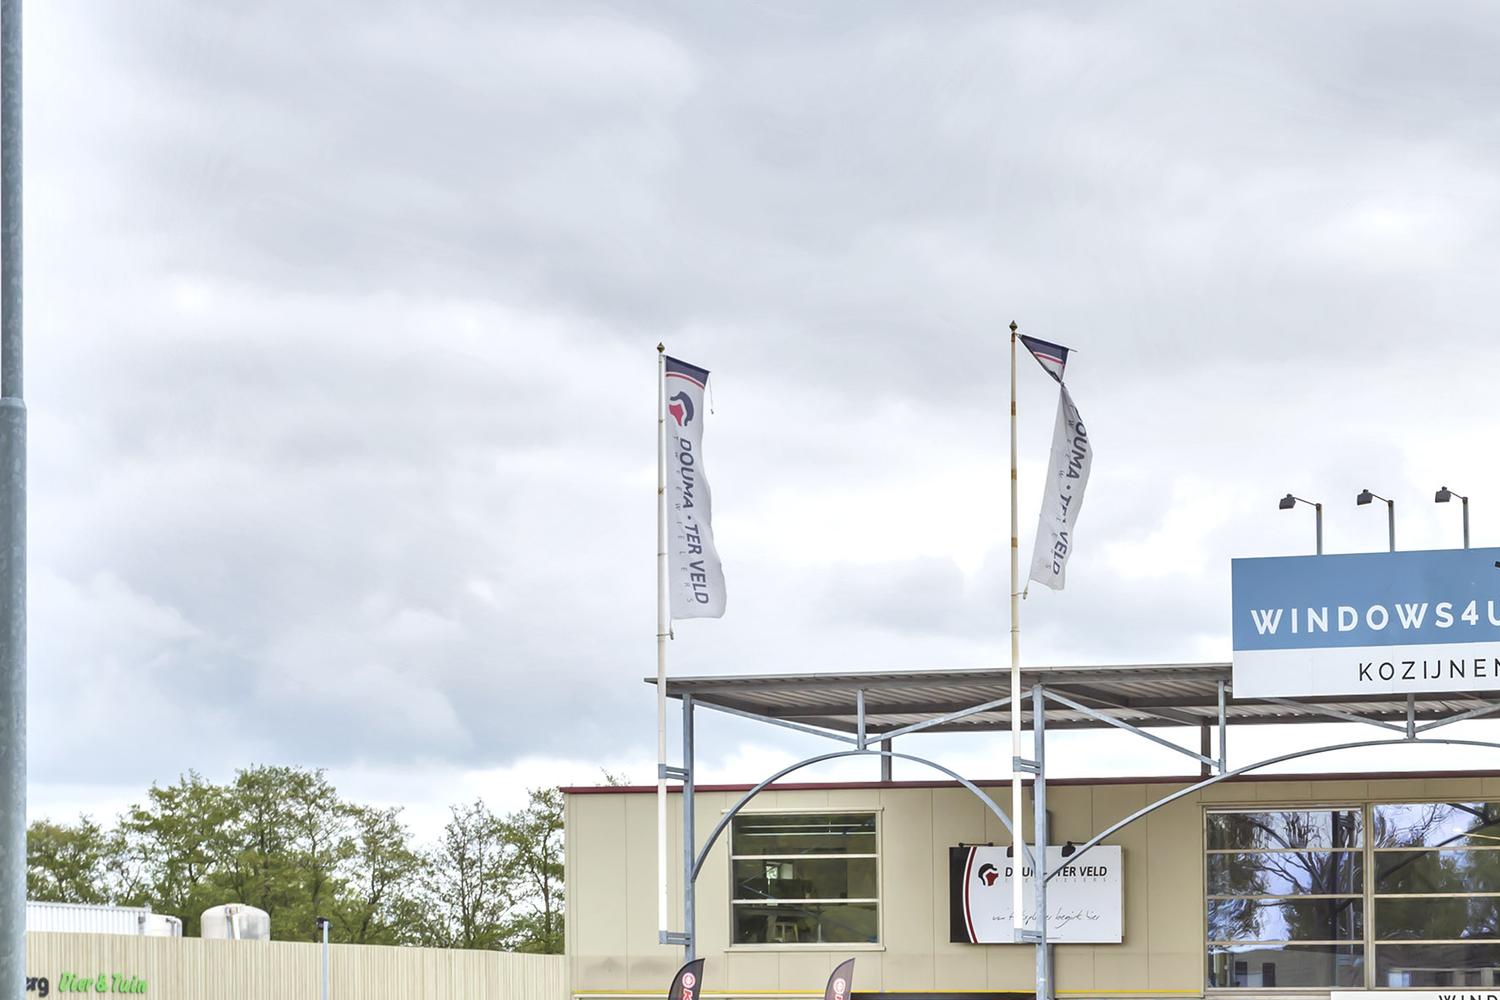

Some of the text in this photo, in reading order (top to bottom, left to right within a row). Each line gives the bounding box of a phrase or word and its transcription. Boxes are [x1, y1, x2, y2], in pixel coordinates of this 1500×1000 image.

[679, 437, 709, 604] DOUMA TER VELD
[1052, 531, 1069, 576] VELD
[1080, 866, 1107, 877] VELD
[95, 973, 107, 993] &
[111, 972, 147, 993] Tuin
